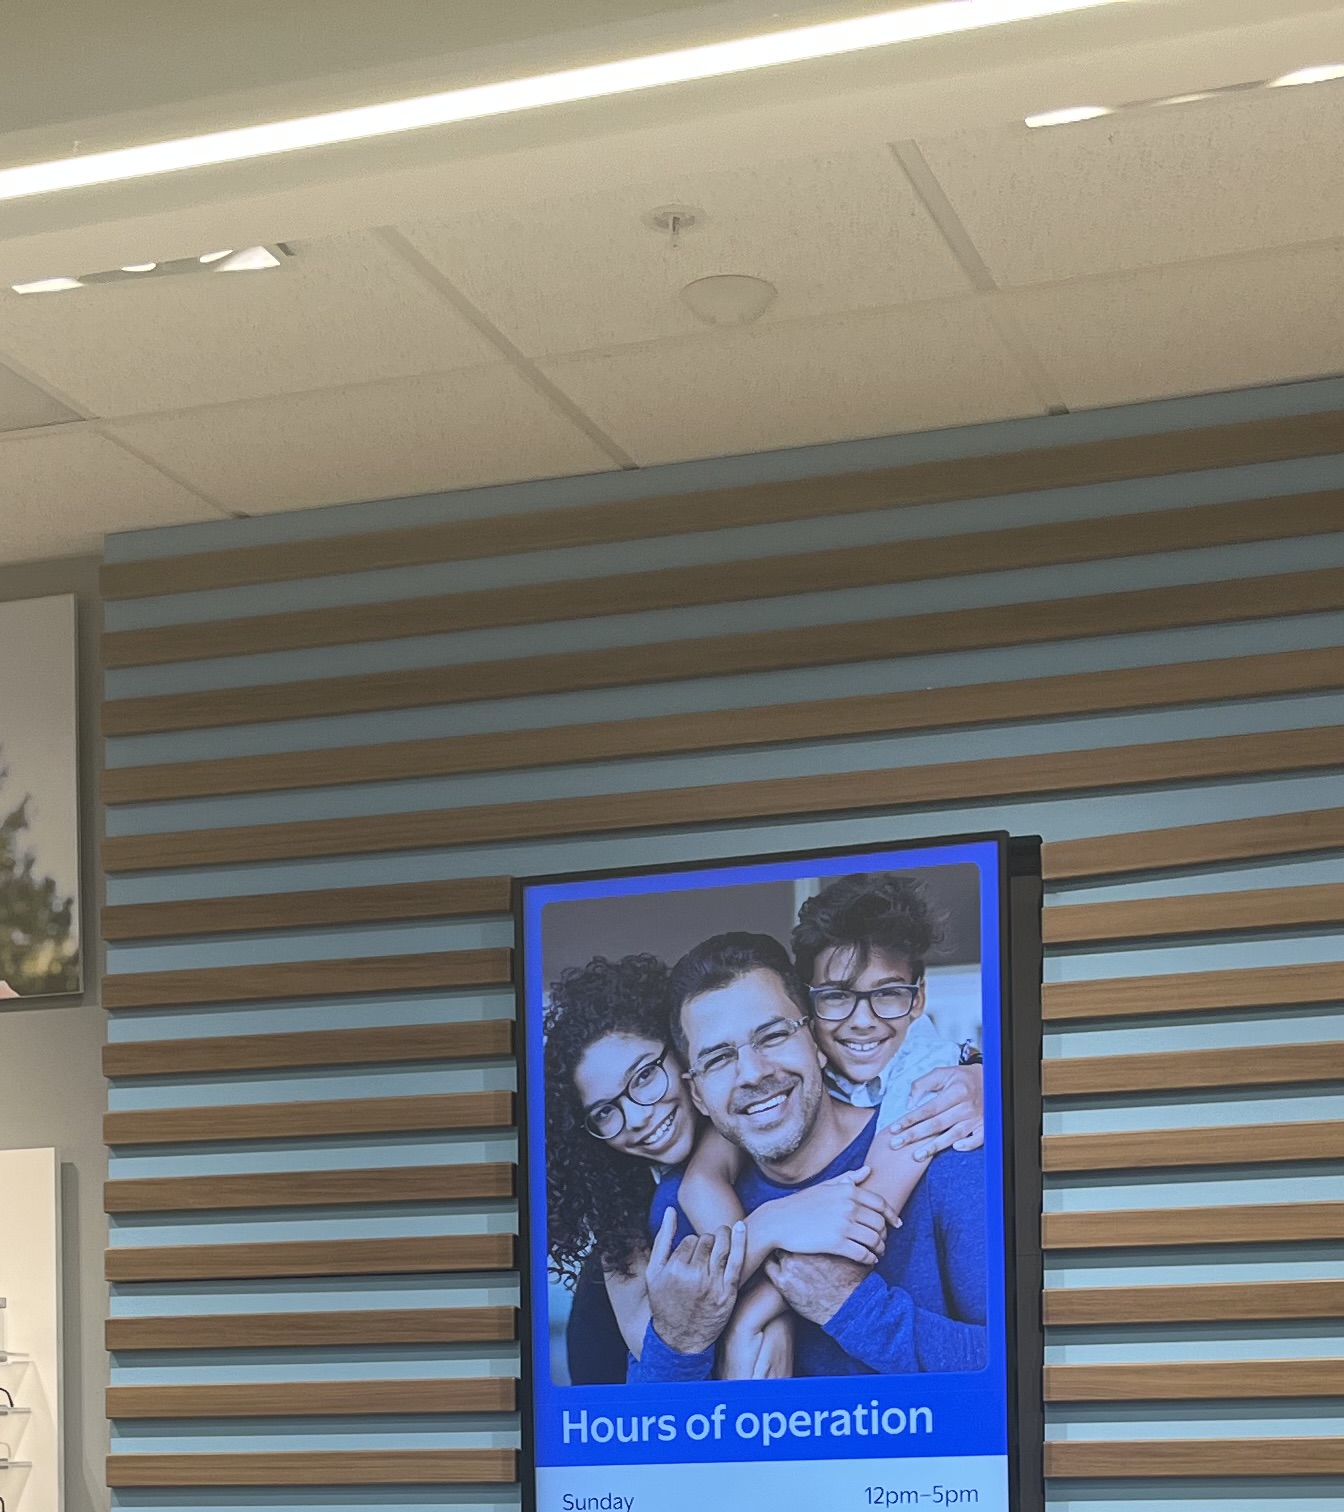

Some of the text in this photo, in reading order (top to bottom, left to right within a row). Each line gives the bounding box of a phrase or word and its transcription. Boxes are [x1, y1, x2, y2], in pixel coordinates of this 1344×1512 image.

[562, 1400, 934, 1446] Hours of operation
[563, 1493, 634, 1512] Sunday
